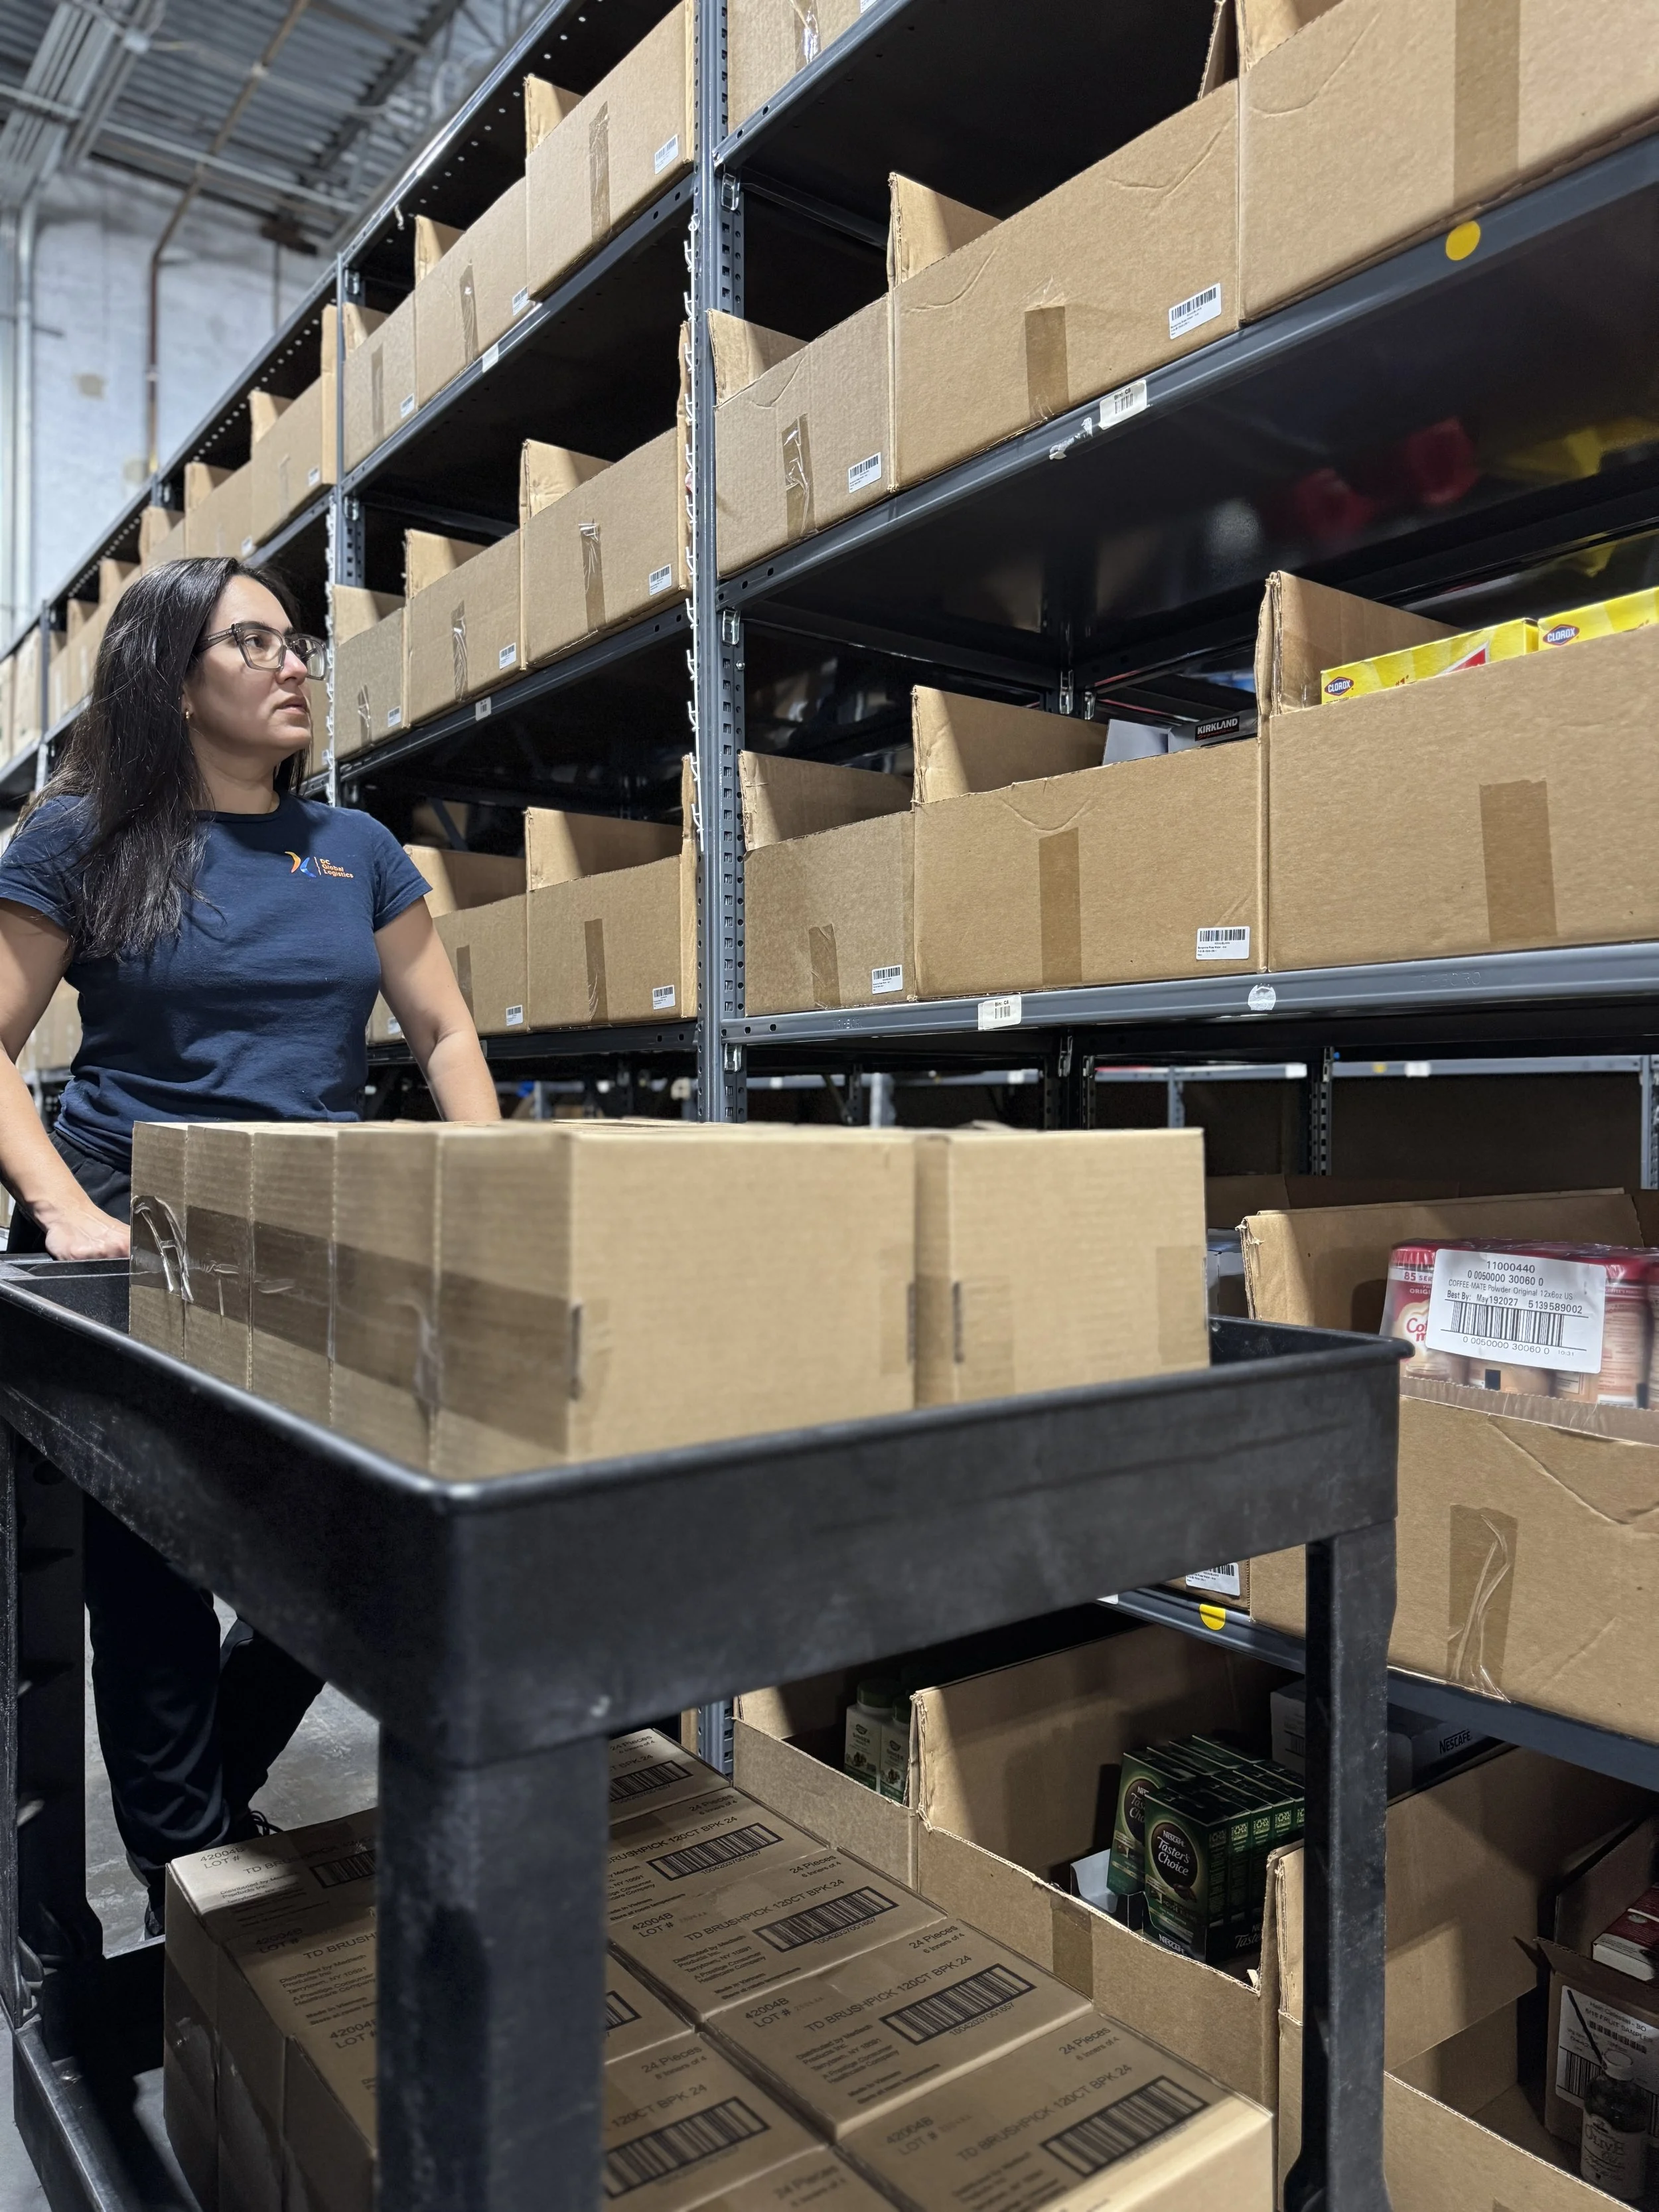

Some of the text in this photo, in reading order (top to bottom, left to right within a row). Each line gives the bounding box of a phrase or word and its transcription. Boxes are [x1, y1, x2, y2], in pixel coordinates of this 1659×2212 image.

[1547, 627, 1575, 642] CLOROX
[1328, 680, 1350, 693] CLOROX
[1197, 718, 1238, 735] KIRKLAND
[322, 863, 344, 872] Global
[323, 869, 354, 878] Logistics
[1486, 1261, 1536, 1274] 11000440
[1404, 1272, 1416, 1281] 85
[1467, 1270, 1544, 1286] 0 0050000 30060 0
[1447, 1290, 1460, 1299] Best
[1461, 1291, 1471, 1301] By:
[1449, 1279, 1486, 1291] COFFEE-MATE
[1488, 1284, 1510, 1293] Powder
[1513, 1287, 1538, 1296] Original
[1540, 1290, 1562, 1299] 12x6oz
[1471, 1337, 1509, 1349] 0050000
[1512, 1343, 1541, 1353] 30060
[622, 1735, 652, 1747] Pieces
[689, 1795, 734, 1812] 24 Pieces
[668, 1829, 701, 1844] 120CT
[701, 1821, 724, 1832] BPK
[200, 1847, 244, 1861] 42004B
[1157, 1836, 1190, 1864] Taster's
[204, 1858, 230, 1869] LOT
[803, 1855, 836, 1869] Pieces
[1157, 1851, 1189, 1876] Choice
[808, 1866, 828, 1876] Inners
[684, 1932, 703, 1941] TD
[703, 1906, 773, 1935] BRUSHPICK
[773, 1893, 806, 1909] 120CT
[806, 1885, 831, 1897] BPK
[632, 1913, 674, 1931] 42004B
[638, 1925, 664, 1938] LOT
[908, 1925, 958, 1949] 24 Pieces
[259, 1942, 286, 1954] LOT
[930, 1939, 952, 1951] Inners
[303, 1949, 323, 1958] TD
[279, 1968, 321, 1984] Distributed
[344, 1966, 366, 1976] 10591
[804, 2020, 826, 2032] TD
[824, 1989, 898, 2024] BRUSHPICK
[897, 1972, 932, 1992] 120CT
[932, 1962, 958, 1976] BPK
[956, 1954, 972, 1965] 24
[745, 1997, 790, 2020] 42004B
[753, 2012, 780, 2028] LOT
[1600, 2014, 1619, 2028] FRUIT
[335, 2032, 365, 2049] LOT
[1058, 2027, 1111, 2055] 24 Pieces
[1106, 2039, 1114, 2047] of
[641, 2045, 703, 2074] 24 Pieces
[611, 2083, 707, 2128] 120CT BPK 24
[956, 2146, 979, 2161] TD
[978, 2106, 1055, 2152] BRUSHPICK
[1053, 2085, 1091, 2110] 120CT
[1090, 2070, 1118, 2091] BPK
[1115, 2063, 1132, 2077] 24
[886, 2116, 934, 2145] 42004B
[898, 2138, 926, 2156] LOT
[1585, 2123, 1624, 2156] OLIVE
